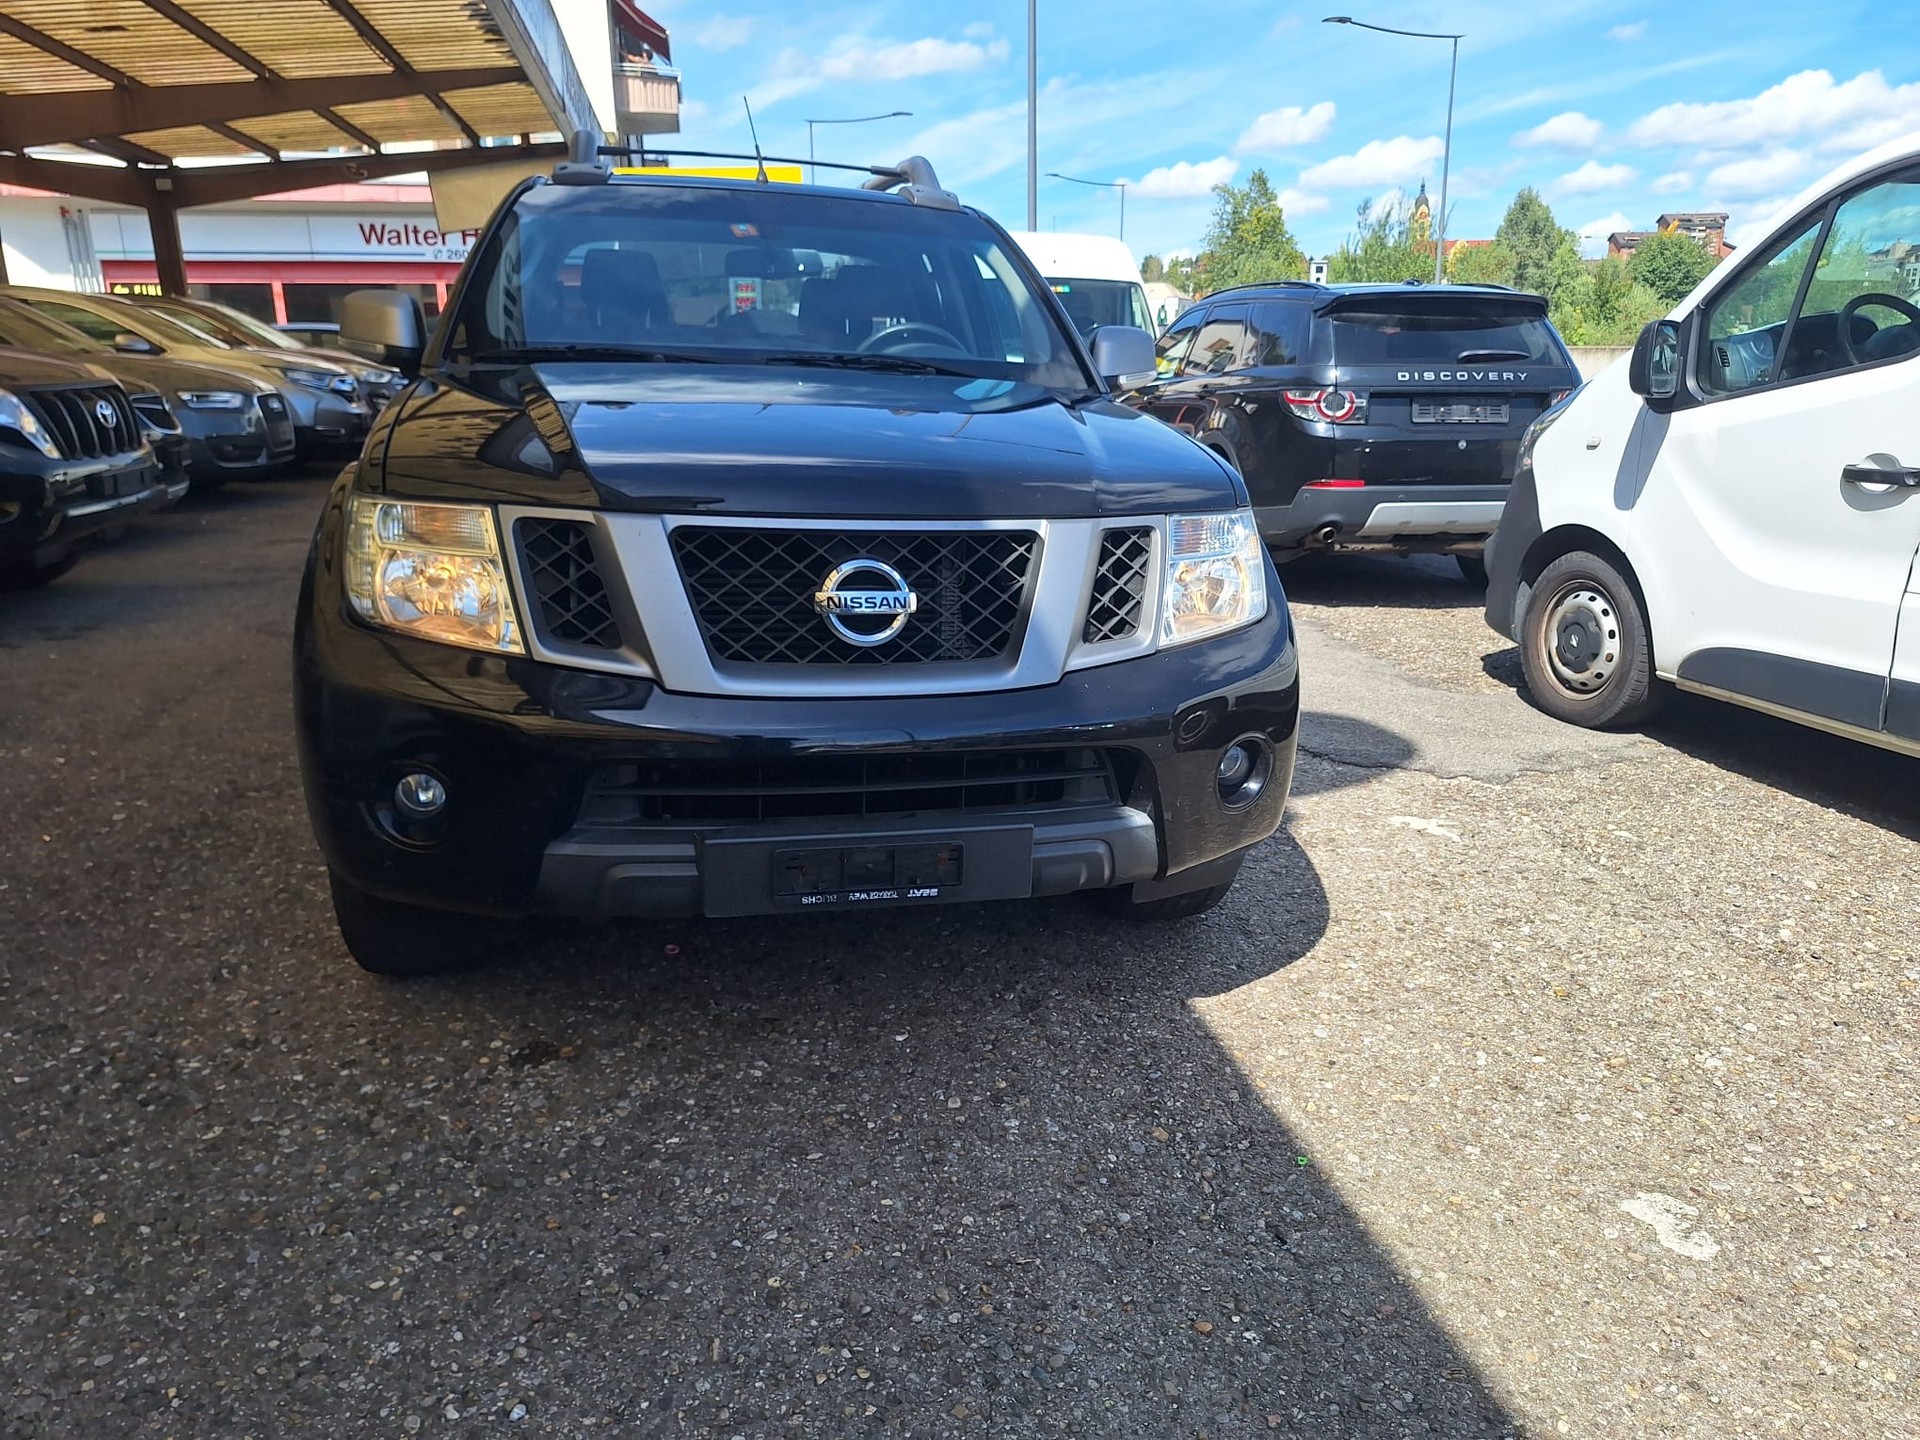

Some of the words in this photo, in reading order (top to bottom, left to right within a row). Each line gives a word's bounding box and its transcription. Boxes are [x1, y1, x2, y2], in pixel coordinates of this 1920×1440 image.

[358, 223, 447, 246] Walter
[1397, 371, 1528, 381] DISCOVERY
[826, 596, 907, 609] NISSAN
[907, 888, 939, 897] SEAT
[801, 895, 837, 904] BUCHS
